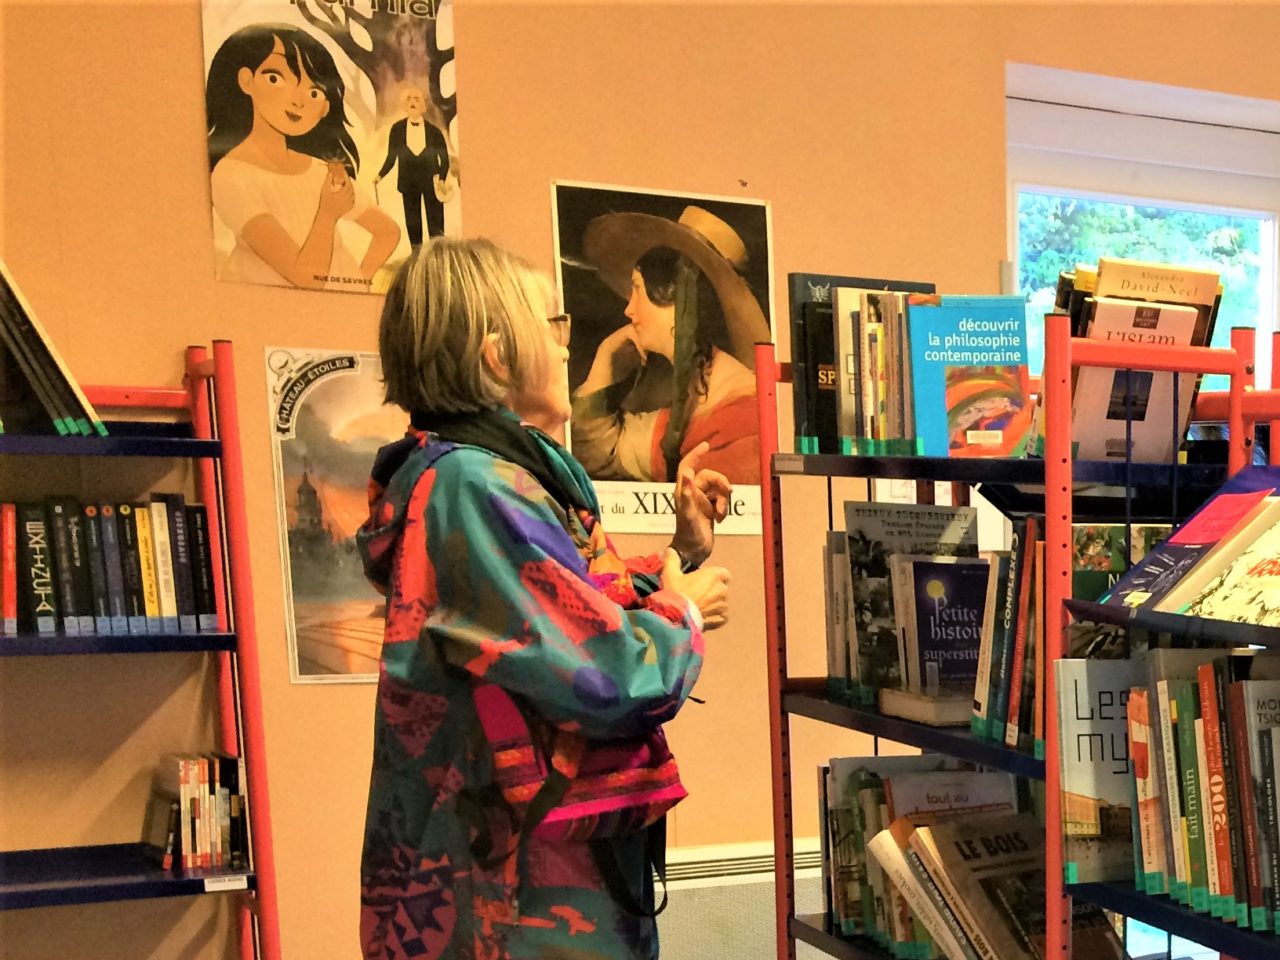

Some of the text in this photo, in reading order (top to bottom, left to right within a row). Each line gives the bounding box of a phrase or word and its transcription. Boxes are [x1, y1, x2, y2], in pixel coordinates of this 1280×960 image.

[958, 317, 1020, 331] découvrir
[928, 332, 1021, 350] la philosophie
[924, 348, 1021, 365] contemporaine
[611, 500, 625, 514] du
[1002, 549, 1018, 629] COMPLEXE
[934, 594, 978, 625] Petite
[1074, 679, 1130, 720] Les
[926, 792, 949, 804] tout
[1184, 768, 1199, 838] fait main
[1208, 774, 1227, 830] 200
[954, 832, 1030, 861] LE BOIS
[1272, 866, 1280, 894] ROMAN
